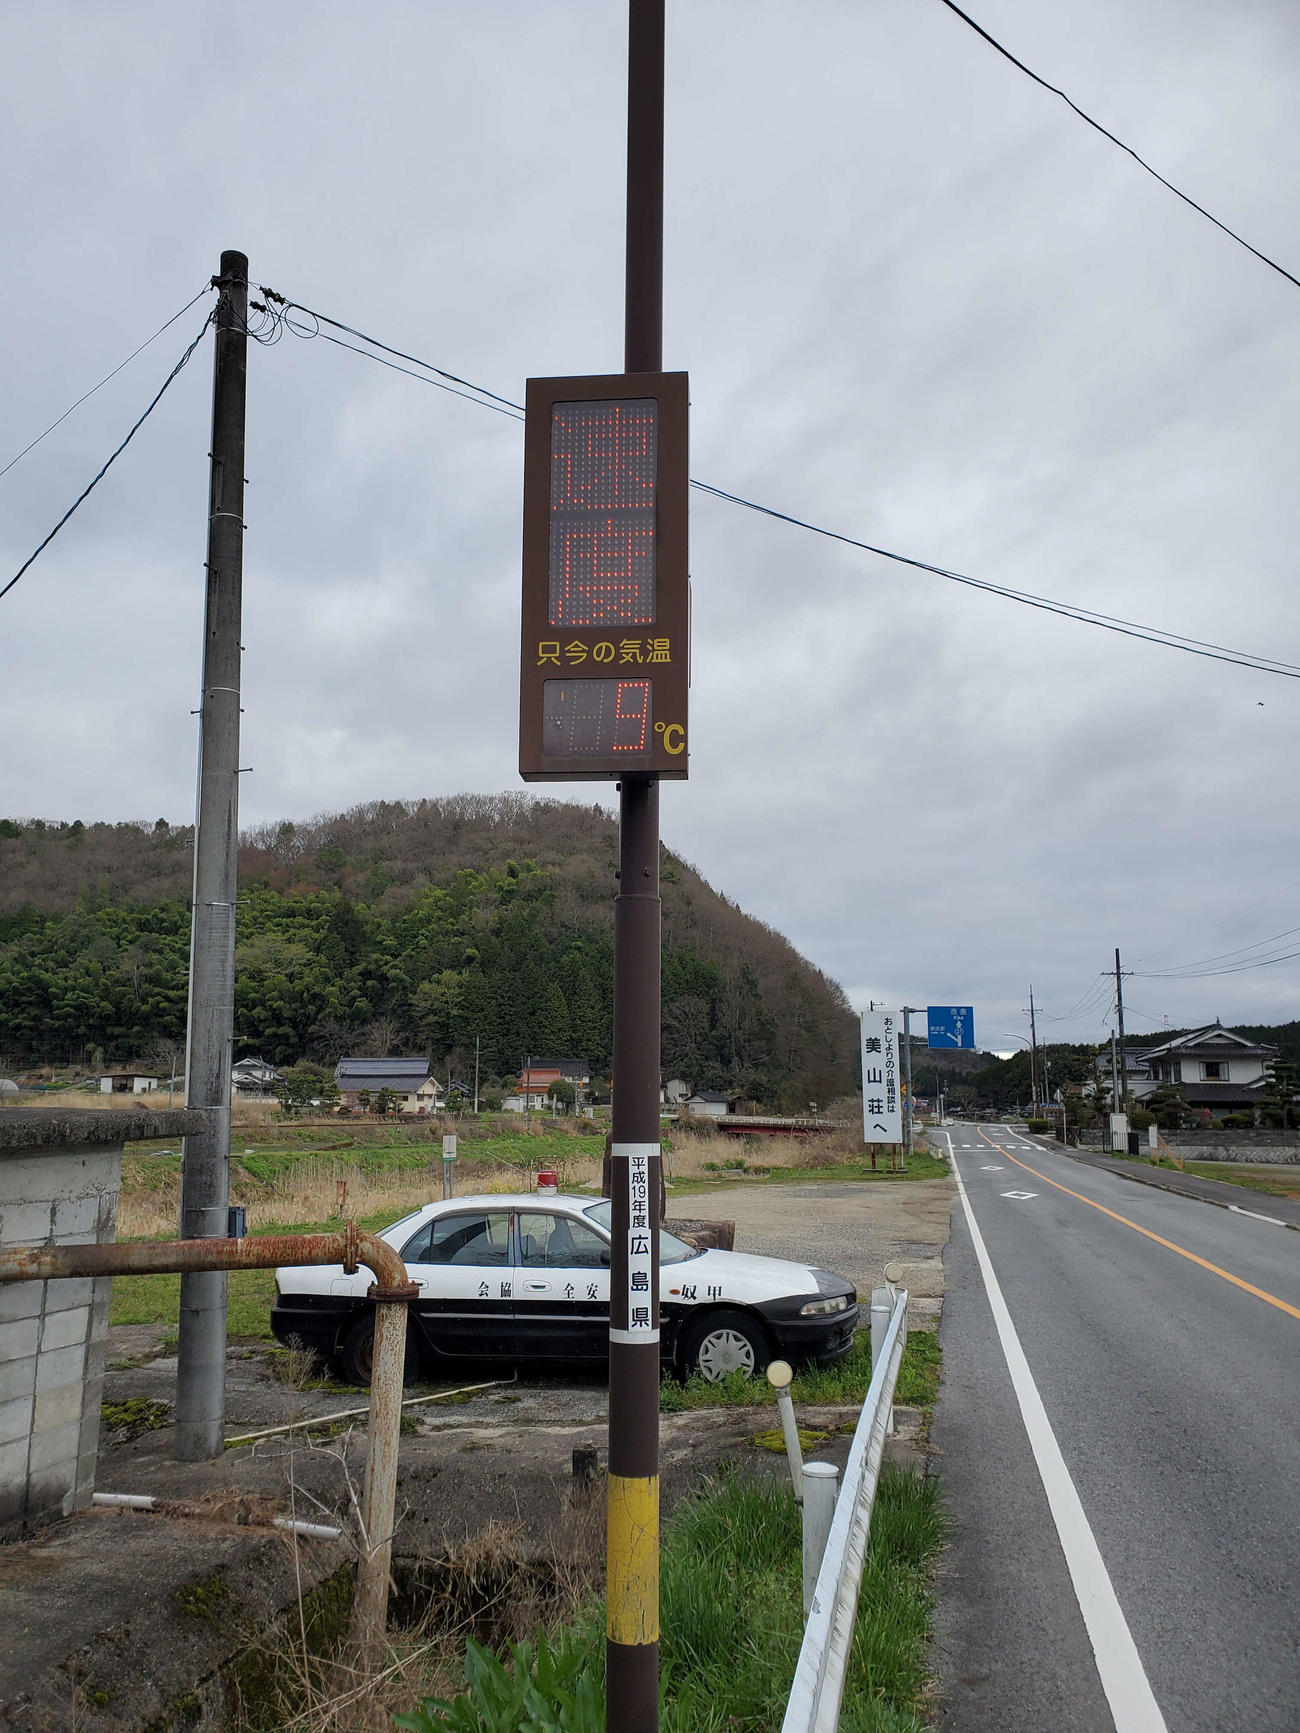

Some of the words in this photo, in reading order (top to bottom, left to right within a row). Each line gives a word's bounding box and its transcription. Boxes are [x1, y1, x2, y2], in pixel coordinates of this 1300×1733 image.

[536, 638, 672, 666] 只今の気温
[612, 681, 649, 750] 9
[865, 1036, 888, 1133] 美山荘へ
[631, 1156, 647, 1229] 平成19年度
[630, 1234, 650, 1328] 広島県
